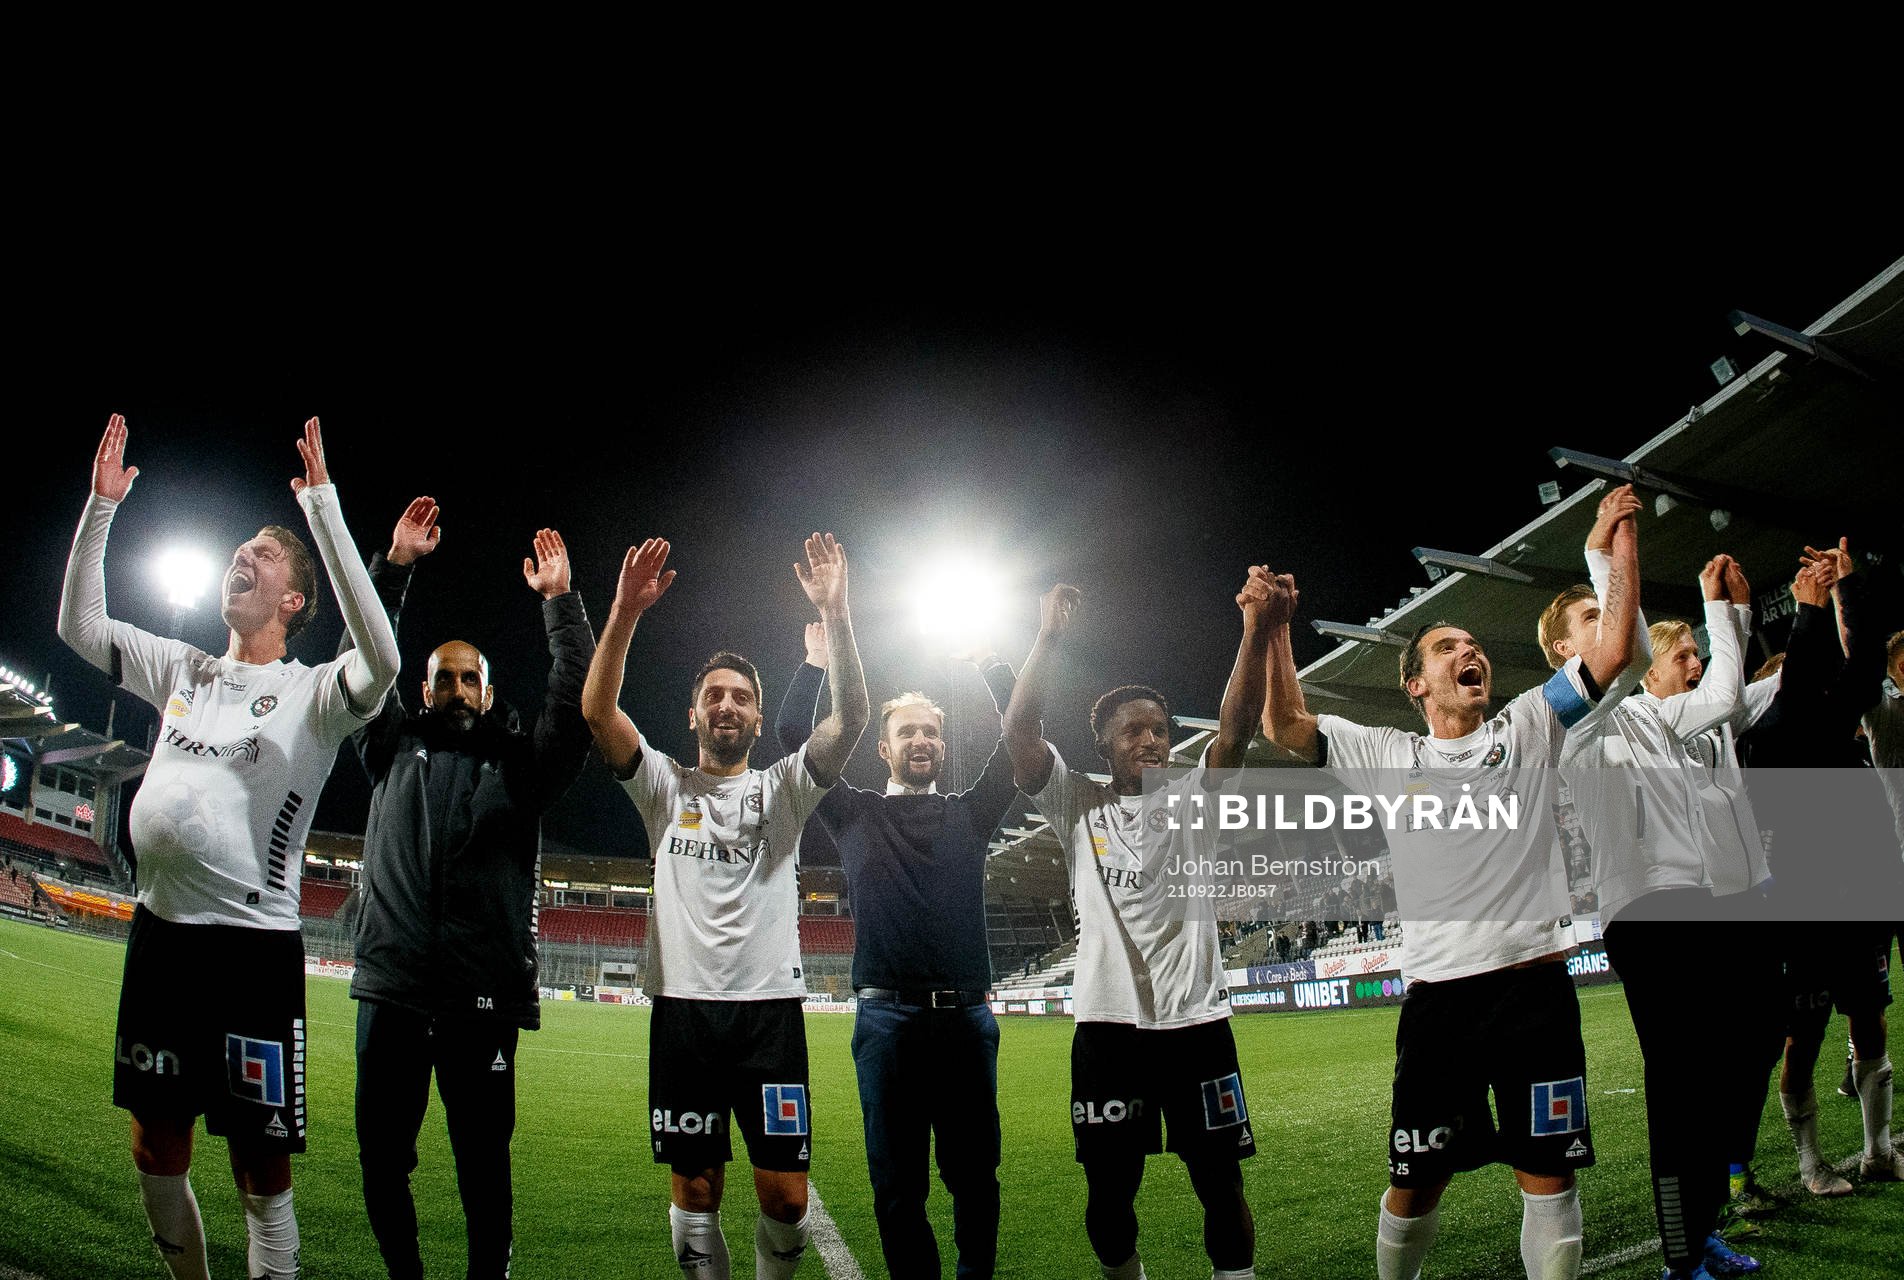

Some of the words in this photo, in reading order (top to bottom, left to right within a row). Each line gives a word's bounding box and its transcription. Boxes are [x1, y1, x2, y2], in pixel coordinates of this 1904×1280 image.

[164, 725, 228, 758] HRN
[1294, 978, 1350, 1008] UNIBET
[477, 996, 494, 1010] DA
[265, 1127, 288, 1138] SELECT
[1565, 1149, 1588, 1158] SELECT
[1396, 1163, 1409, 1175] 25
